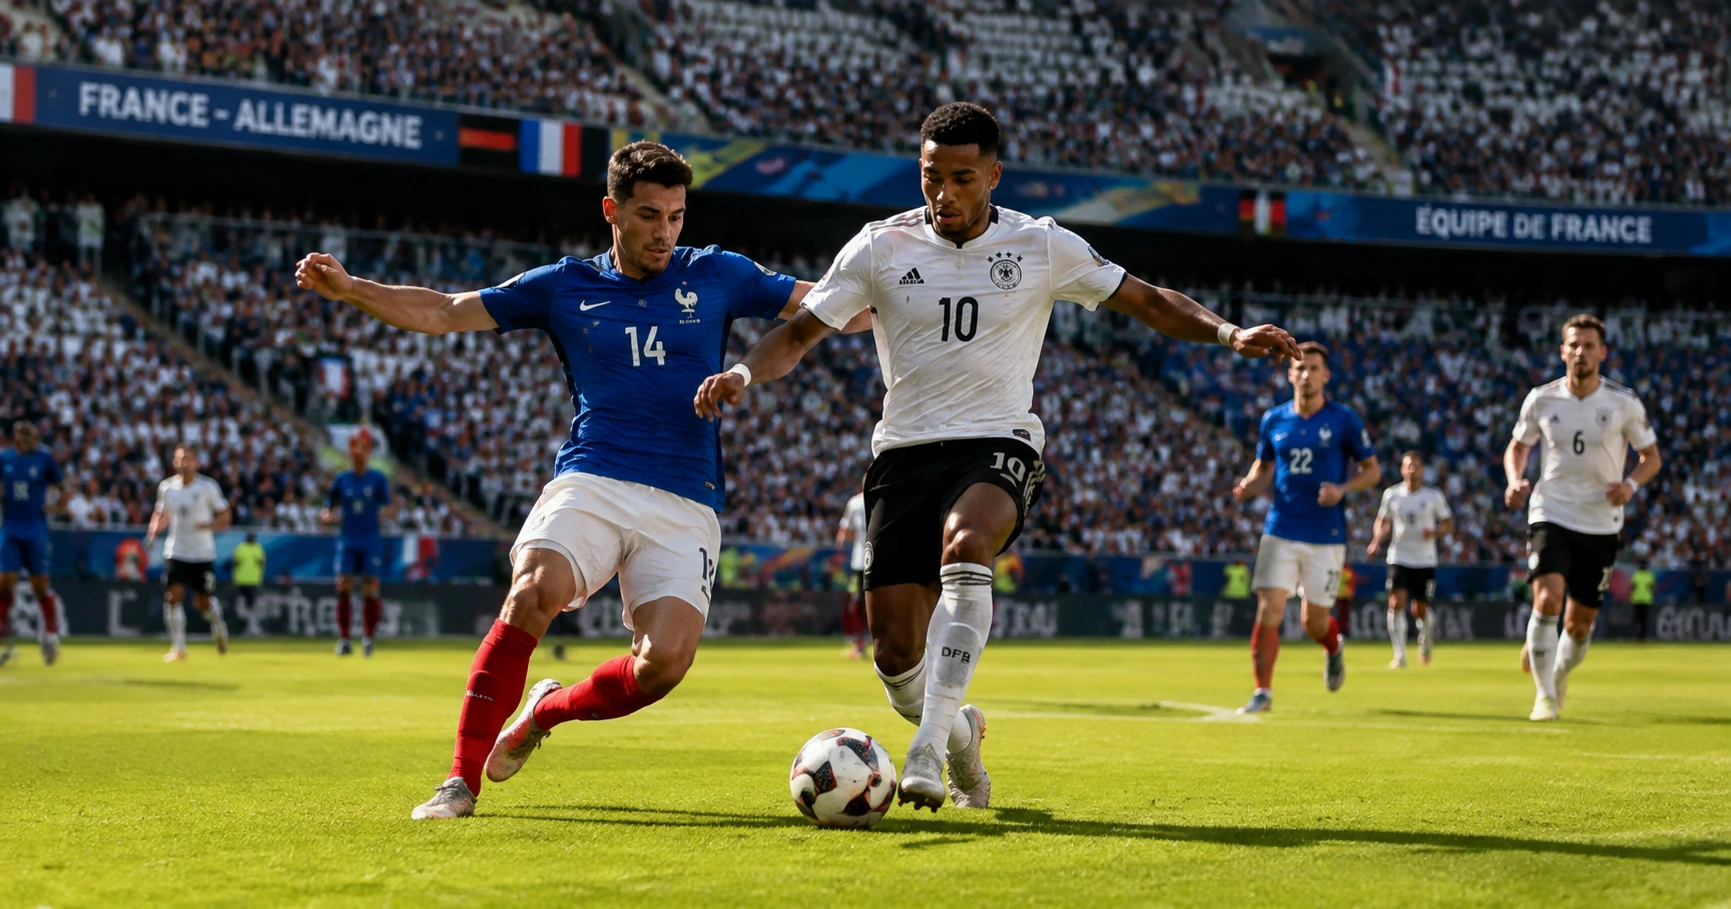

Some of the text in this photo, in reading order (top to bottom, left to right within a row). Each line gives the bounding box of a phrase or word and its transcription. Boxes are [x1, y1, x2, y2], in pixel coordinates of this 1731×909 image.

[79, 81, 423, 149] FRANCE - ALLEMAGNE
[1415, 203, 1653, 243] ÉQUIPE DE FRANCE
[939, 296, 979, 342] 10
[625, 326, 666, 366] 14
[1573, 429, 1585, 455] 6
[990, 452, 1026, 482] 10
[1289, 447, 1313, 475] 22
[941, 646, 971, 664] DFB
